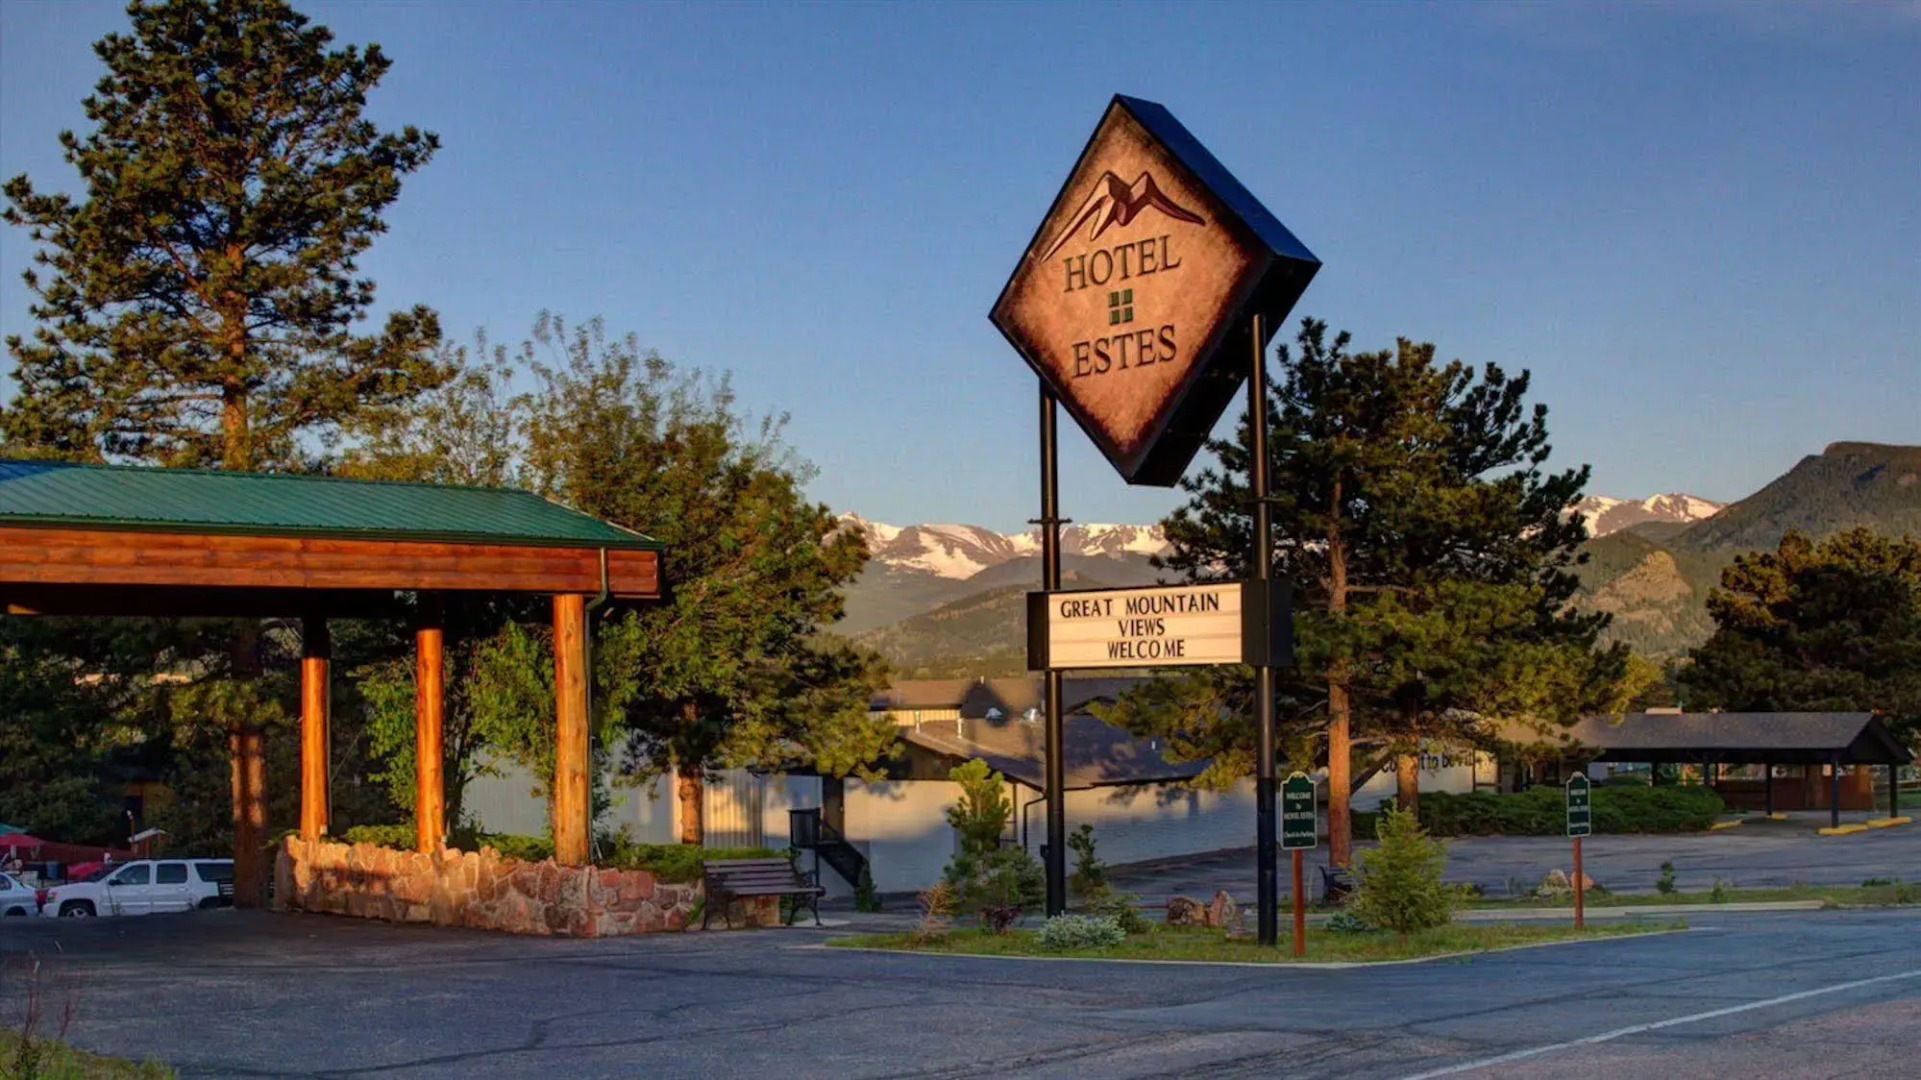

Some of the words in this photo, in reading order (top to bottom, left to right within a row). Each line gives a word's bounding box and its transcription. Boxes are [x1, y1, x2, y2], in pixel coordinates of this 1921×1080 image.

[1063, 234, 1182, 293] HOTEL
[1072, 324, 1177, 378] ESTES
[1060, 598, 1113, 618] GREAT
[1125, 592, 1220, 616] MOUNTAIN
[1118, 618, 1165, 637] VIEWS
[1107, 639, 1185, 659] WELCOME
